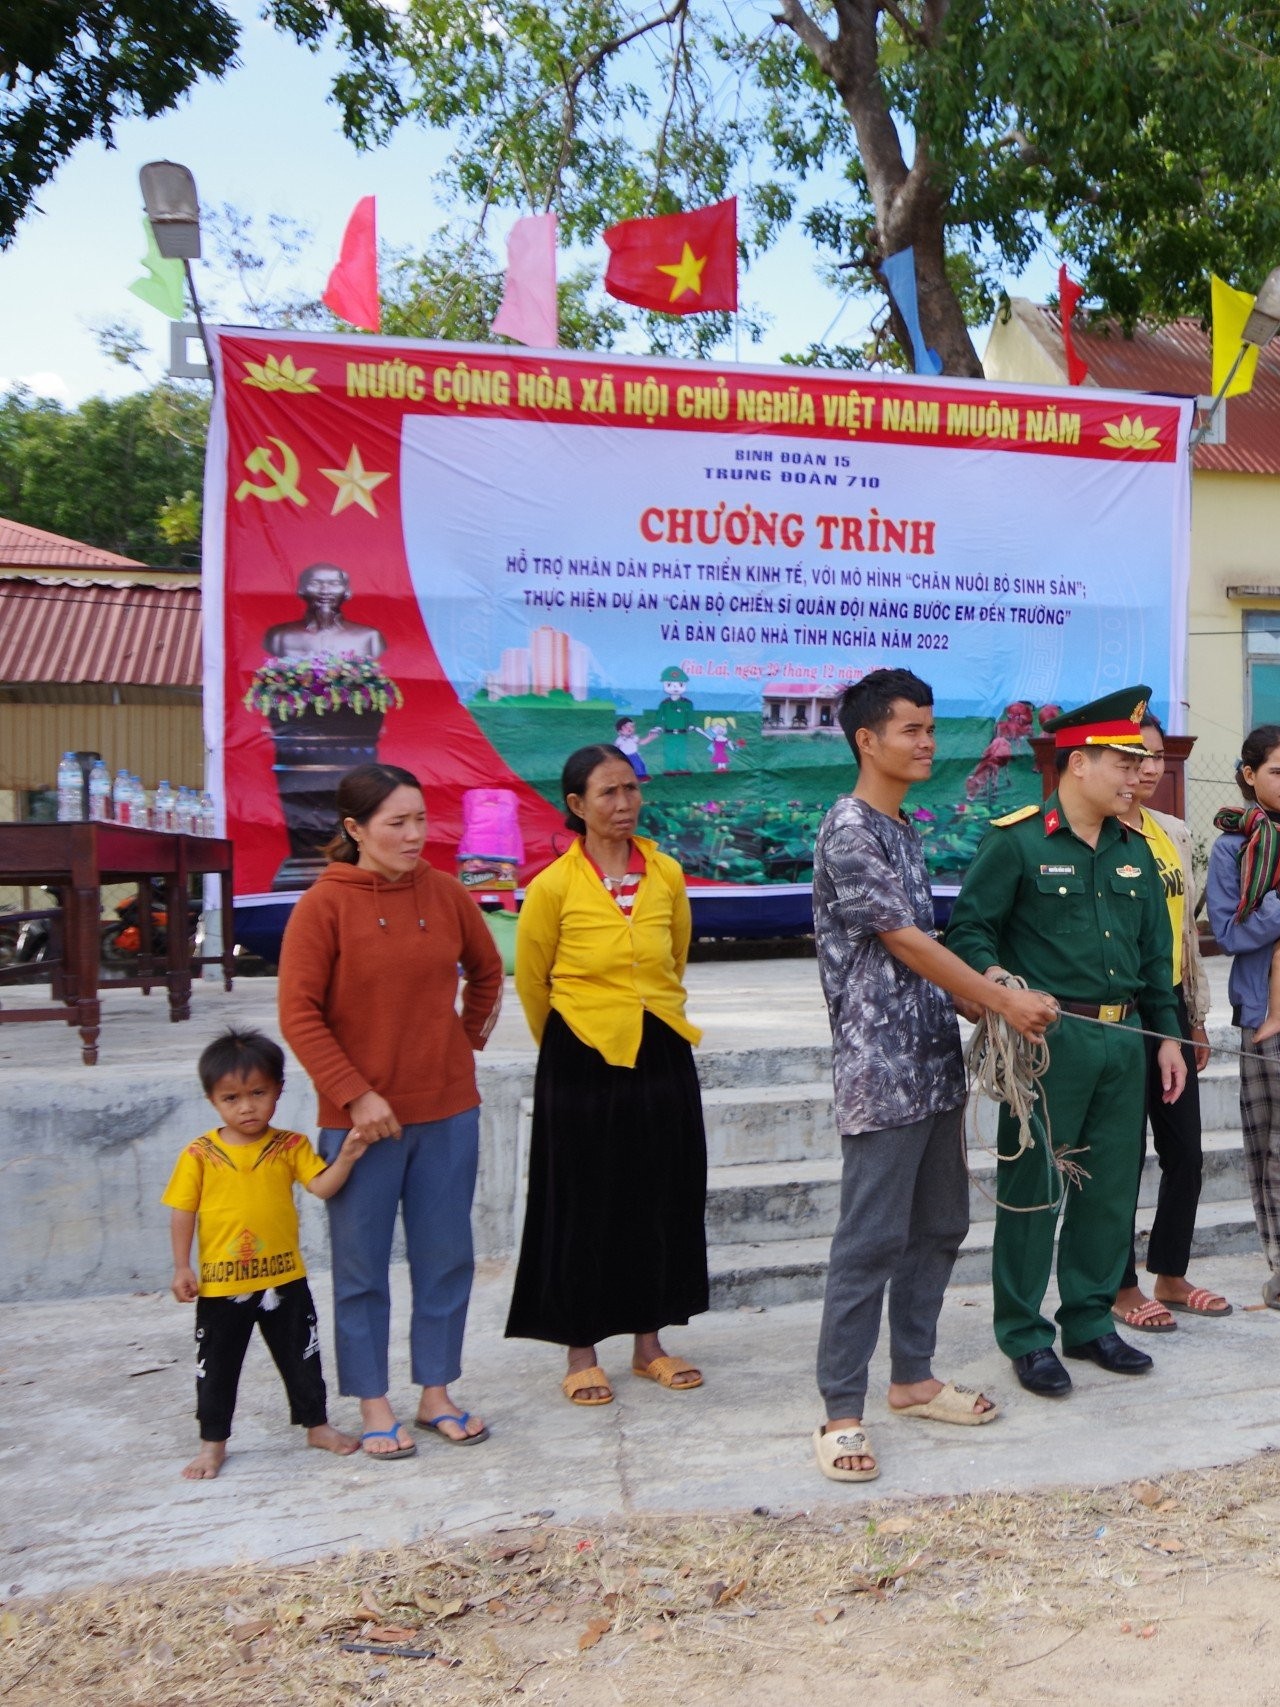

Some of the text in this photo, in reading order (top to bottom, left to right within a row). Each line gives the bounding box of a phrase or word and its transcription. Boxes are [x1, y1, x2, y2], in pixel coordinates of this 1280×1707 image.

[346, 358, 1080, 445] NƯỚC CỘNG HÒA XÃ HỘI CHỦ NGHĨA VIỆT NAM MUÔN NĂM
[735, 449, 850, 467] BINH ĐOÀN 15
[704, 467, 880, 488] TRUNG ĐOÀN 710
[640, 501, 936, 554] CHƯƠNG TRÌNH
[506, 548, 528, 574] HỖ
[533, 556, 563, 580] TRỢ
[568, 556, 611, 576] NHÂN
[617, 558, 647, 578] DÂN
[652, 558, 691, 579] PHÁT
[697, 556, 741, 581] TRIỂN
[746, 565, 780, 583] KINH
[786, 561, 807, 587] TẾ,
[812, 564, 836, 585] VỚI
[841, 567, 862, 586] MÔ
[867, 567, 901, 588] HÌNH
[955, 572, 989, 592] NUÔI
[994, 573, 1010, 593] BÒ
[1013, 578, 1045, 594] SINH
[523, 587, 565, 611] THỰC
[570, 588, 607, 613] HIỆN
[612, 589, 633, 614] DỰ
[637, 589, 658, 610] ÁN
[705, 592, 724, 616] BỘ
[729, 590, 773, 613] CHIẾN
[778, 594, 791, 614] SĨ
[796, 595, 835, 616] QUÂN
[840, 597, 864, 621] ĐỘI
[869, 598, 908, 618] NÂNG
[913, 599, 951, 621] BƯỚC
[955, 605, 975, 621] EM
[979, 602, 1005, 622] ĐẾN
[661, 619, 949, 650] VÀ BÀN GIAO NHÀ TÌNH NGHĨA NĂM 2022
[681, 659, 702, 675] Gia
